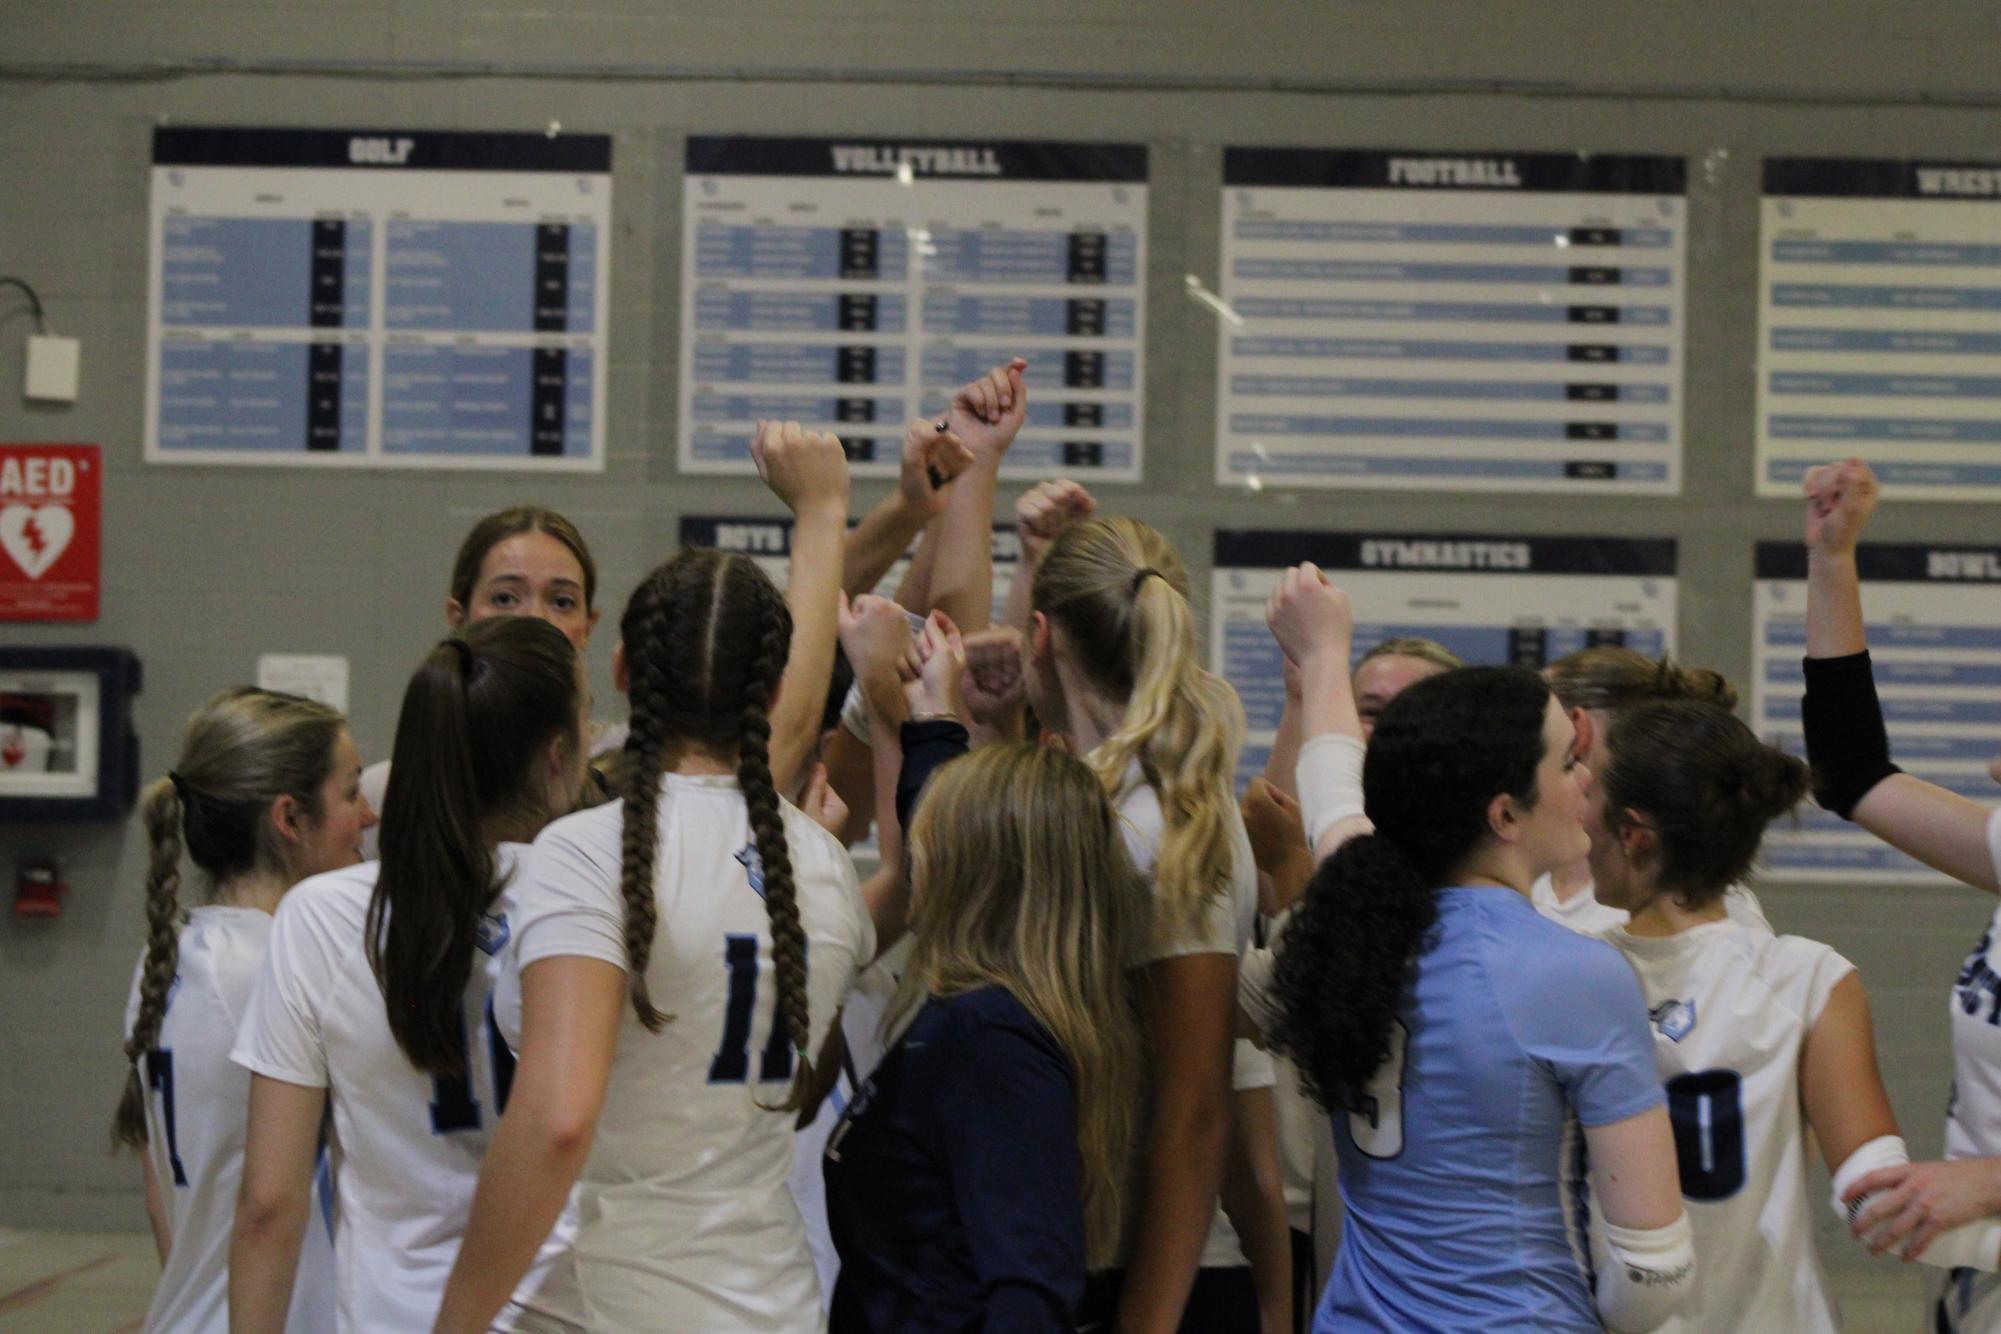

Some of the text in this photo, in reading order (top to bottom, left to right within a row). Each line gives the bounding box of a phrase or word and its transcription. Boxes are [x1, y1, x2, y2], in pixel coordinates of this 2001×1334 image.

[349, 137, 415, 163] GOLF
[830, 145, 1002, 173] VOLLEYBALL
[1388, 157, 1521, 185] FOOTBALL
[0, 456, 76, 495] AED
[1360, 538, 1531, 569] GYMNASTICS
